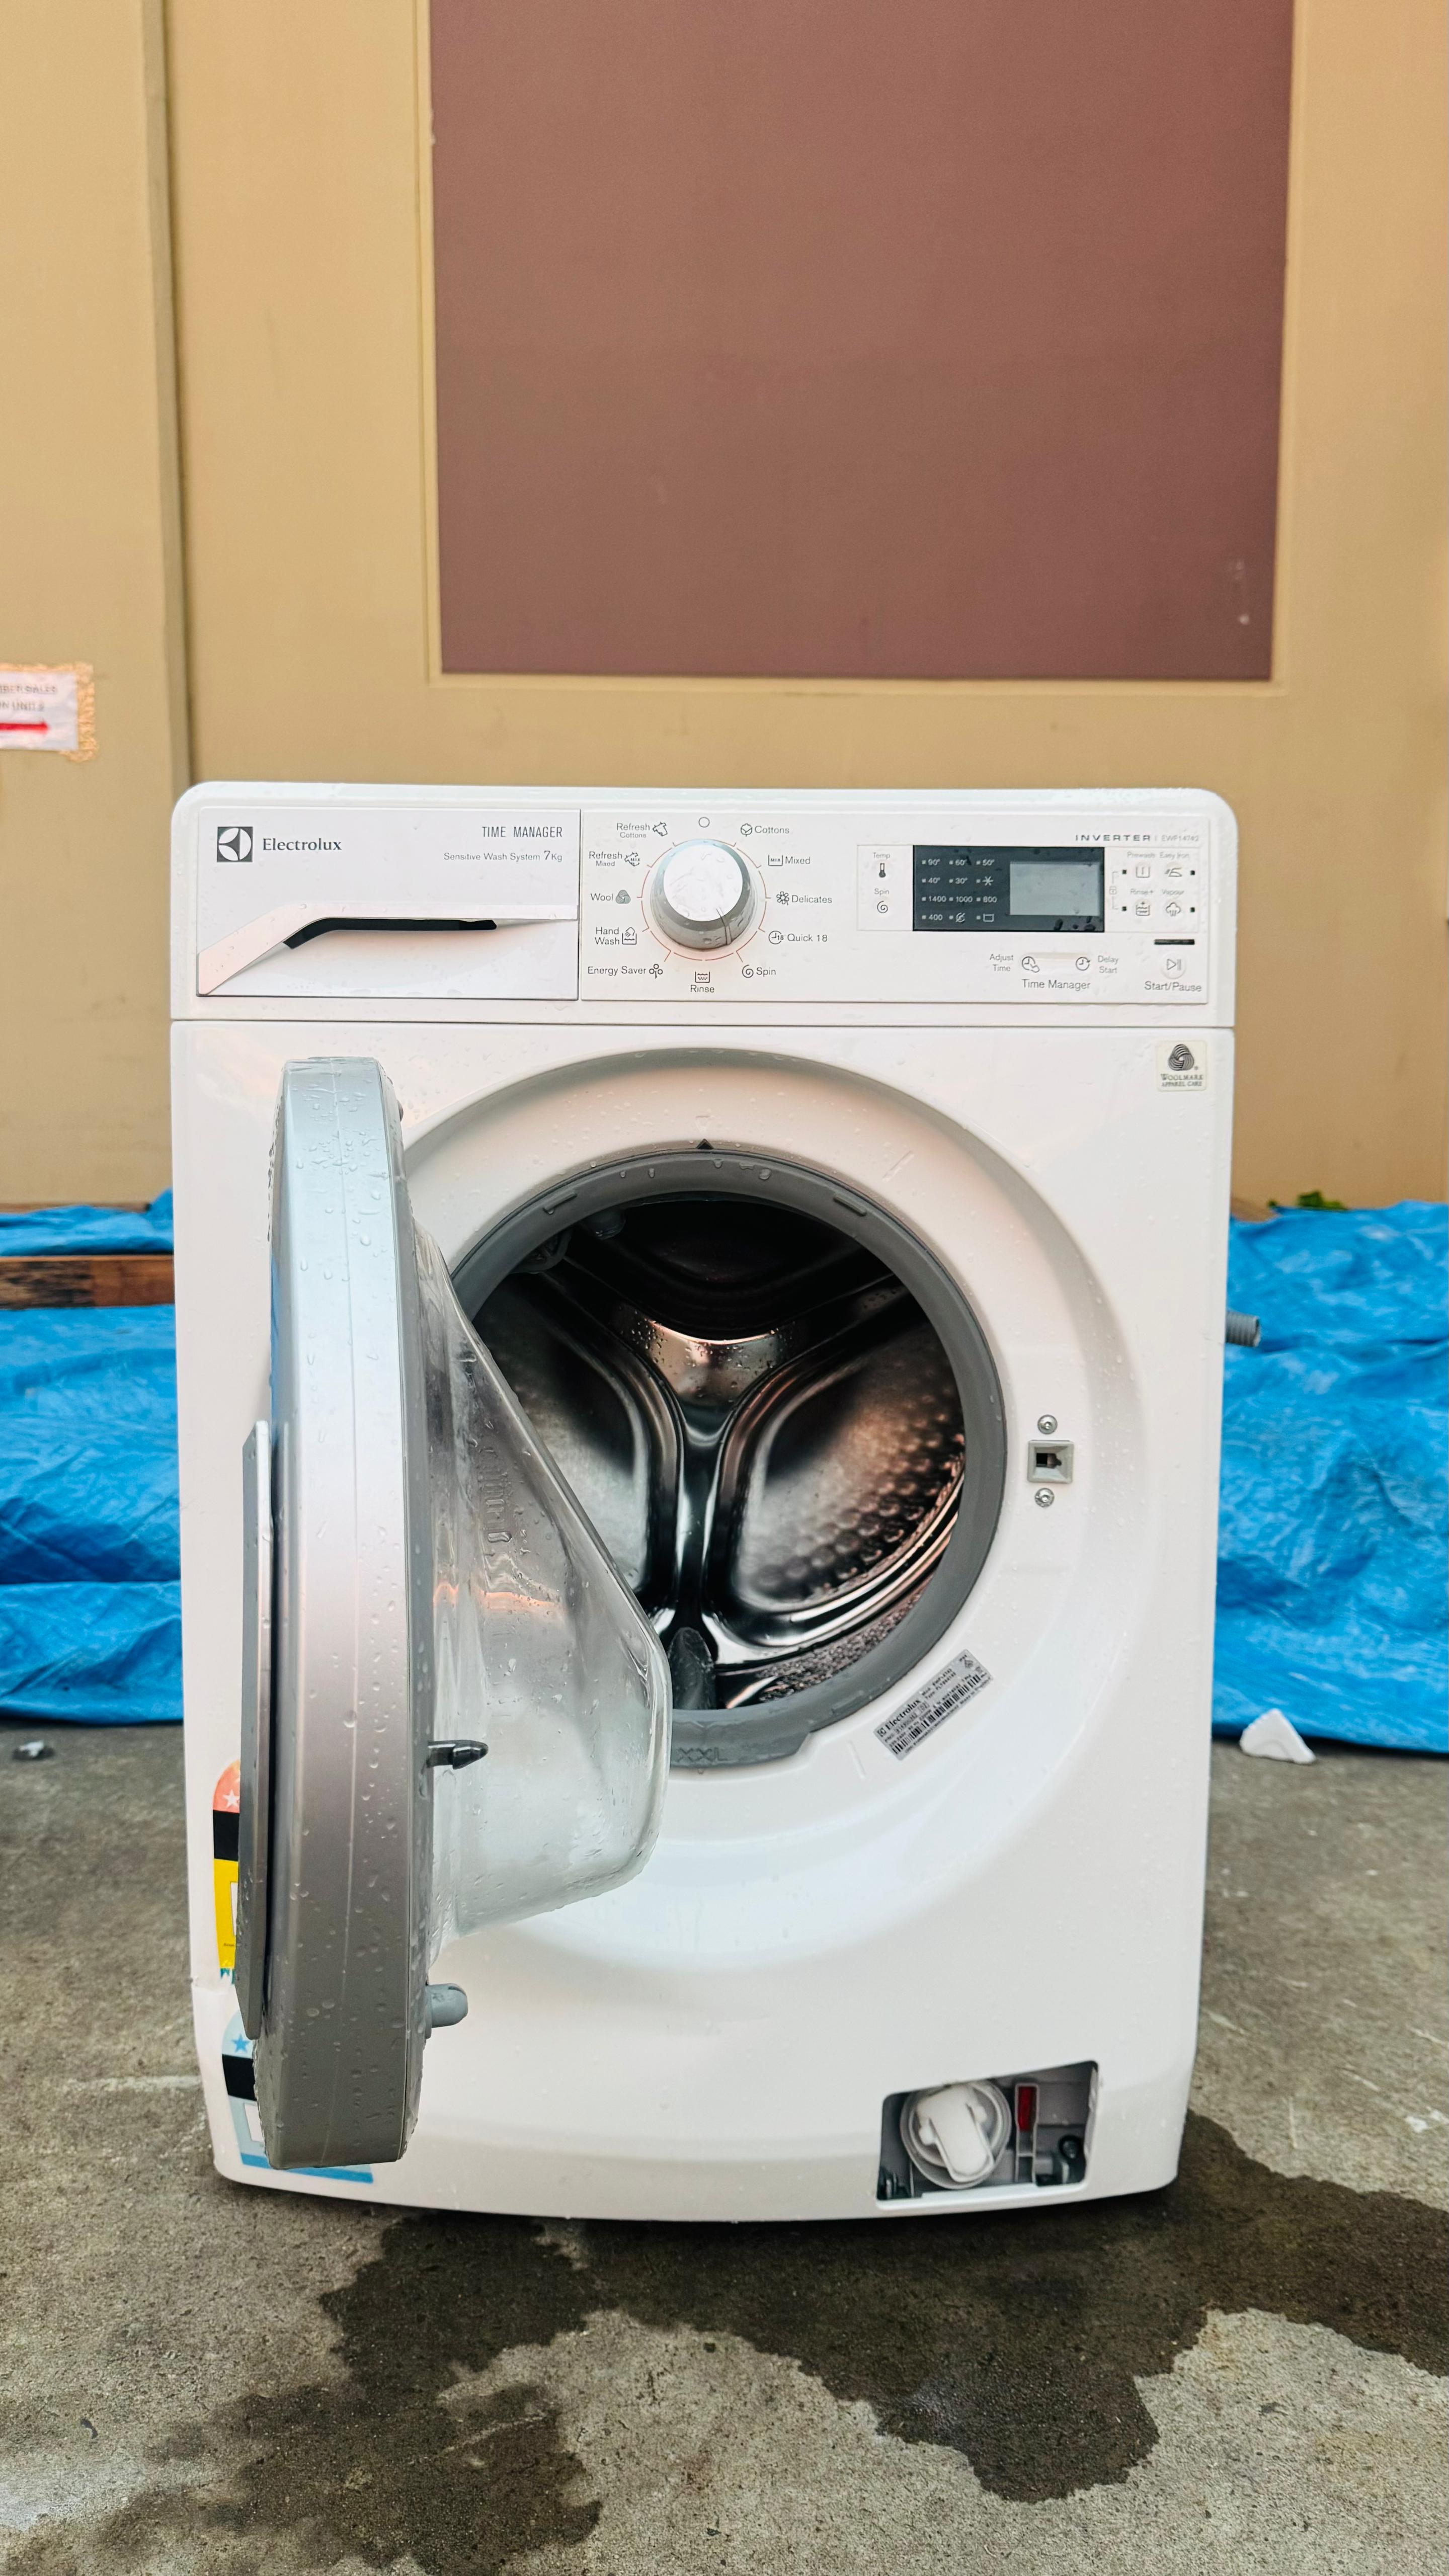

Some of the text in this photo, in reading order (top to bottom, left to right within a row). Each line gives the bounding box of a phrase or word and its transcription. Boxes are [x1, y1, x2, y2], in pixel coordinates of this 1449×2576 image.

[482, 827, 562, 838] TIME MANAGER
[755, 826, 789, 834] Cottons
[263, 838, 342, 850] Electrolux
[510, 853, 540, 862] System
[785, 856, 811, 864] Mixed
[1160, 852, 1175, 860] Easy
[792, 895, 832, 904] Delicates
[595, 937, 619, 945] Wash
[787, 933, 813, 942] Quick
[989, 954, 1014, 962] Adjust
[1098, 955, 1118, 964] Delay
[588, 966, 646, 976] Energy Saver
[756, 967, 776, 977] Spin
[1099, 966, 1117, 974] Start
[690, 985, 715, 993] Rinse
[1022, 979, 1090, 991] Time Manager
[1144, 981, 1201, 992] Start/Pause
[884, 1697, 921, 1731] Electrolux
[677, 1747, 728, 1762] XXL
